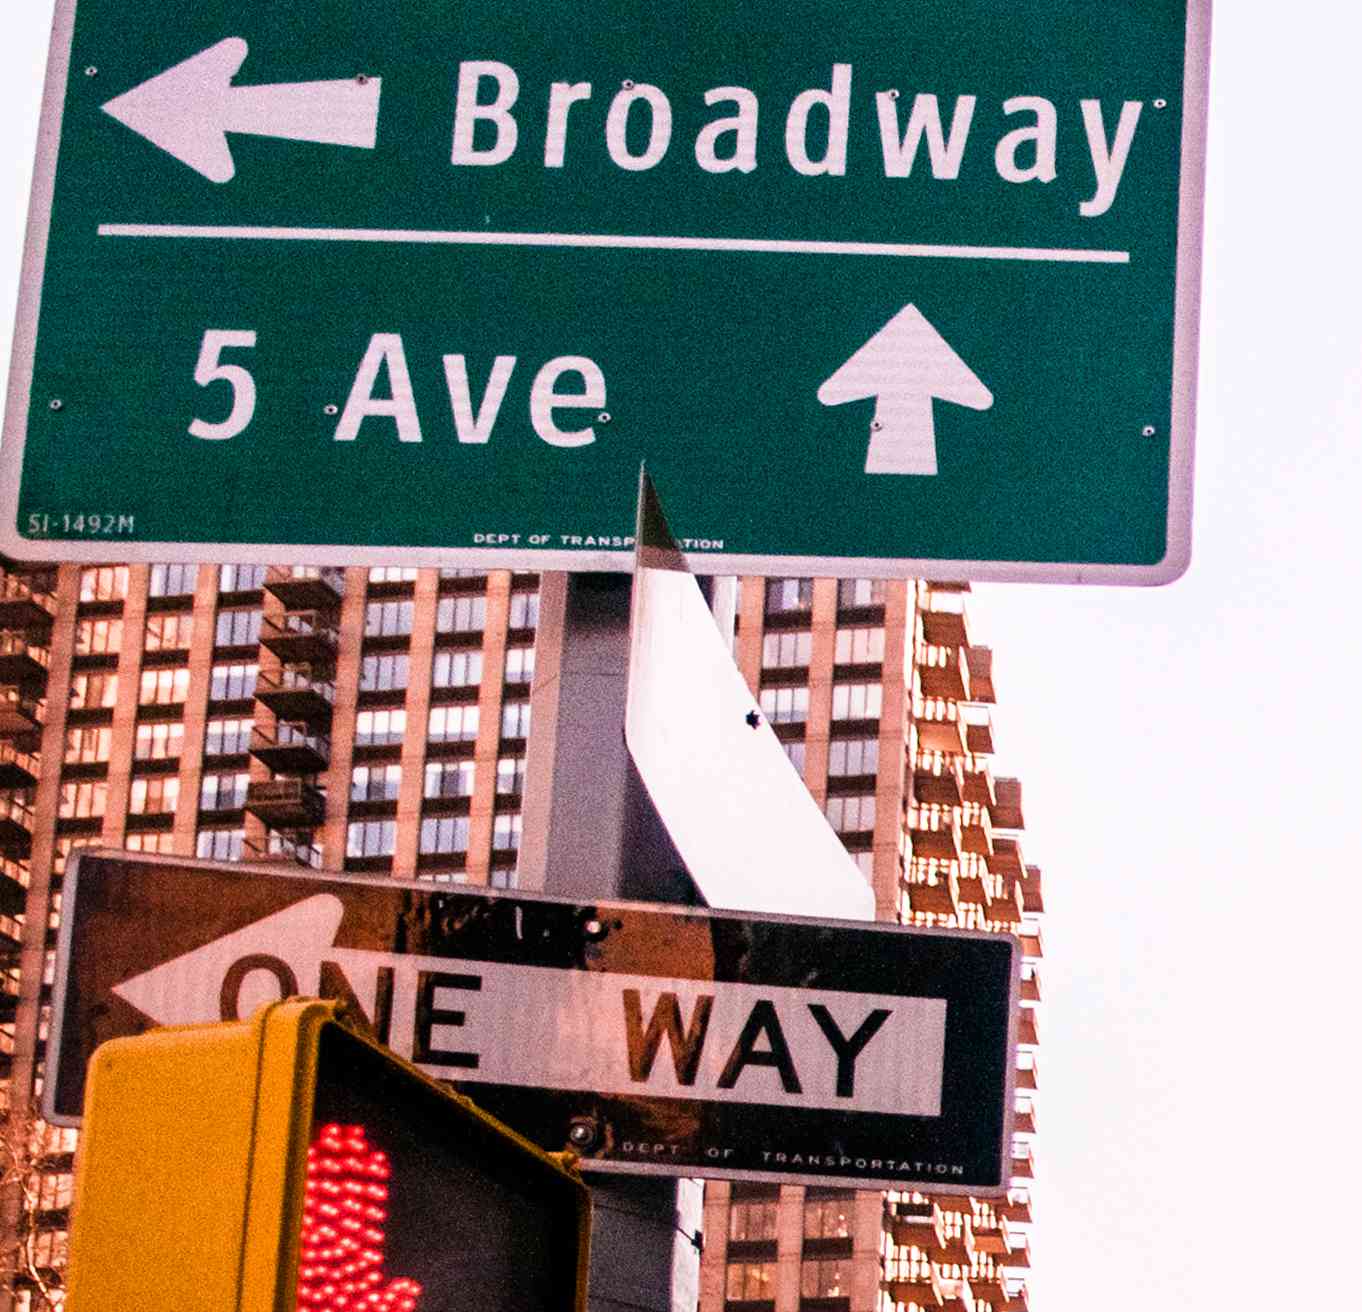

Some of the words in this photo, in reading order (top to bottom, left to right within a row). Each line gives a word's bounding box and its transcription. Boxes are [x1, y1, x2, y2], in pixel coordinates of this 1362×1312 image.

[450, 59, 1144, 217] Broadway
[188, 328, 258, 442] 5
[333, 332, 609, 448] Ave
[473, 532, 521, 545] DEPT
[528, 534, 551, 546] OF
[560, 535, 724, 550] TRANSPTION
[219, 952, 482, 1069] ONE
[621, 987, 894, 1099] WAY
[622, 1140, 678, 1156] DEPT
[707, 1147, 734, 1160] OF
[762, 1150, 964, 1176] TRANSPORTATION
